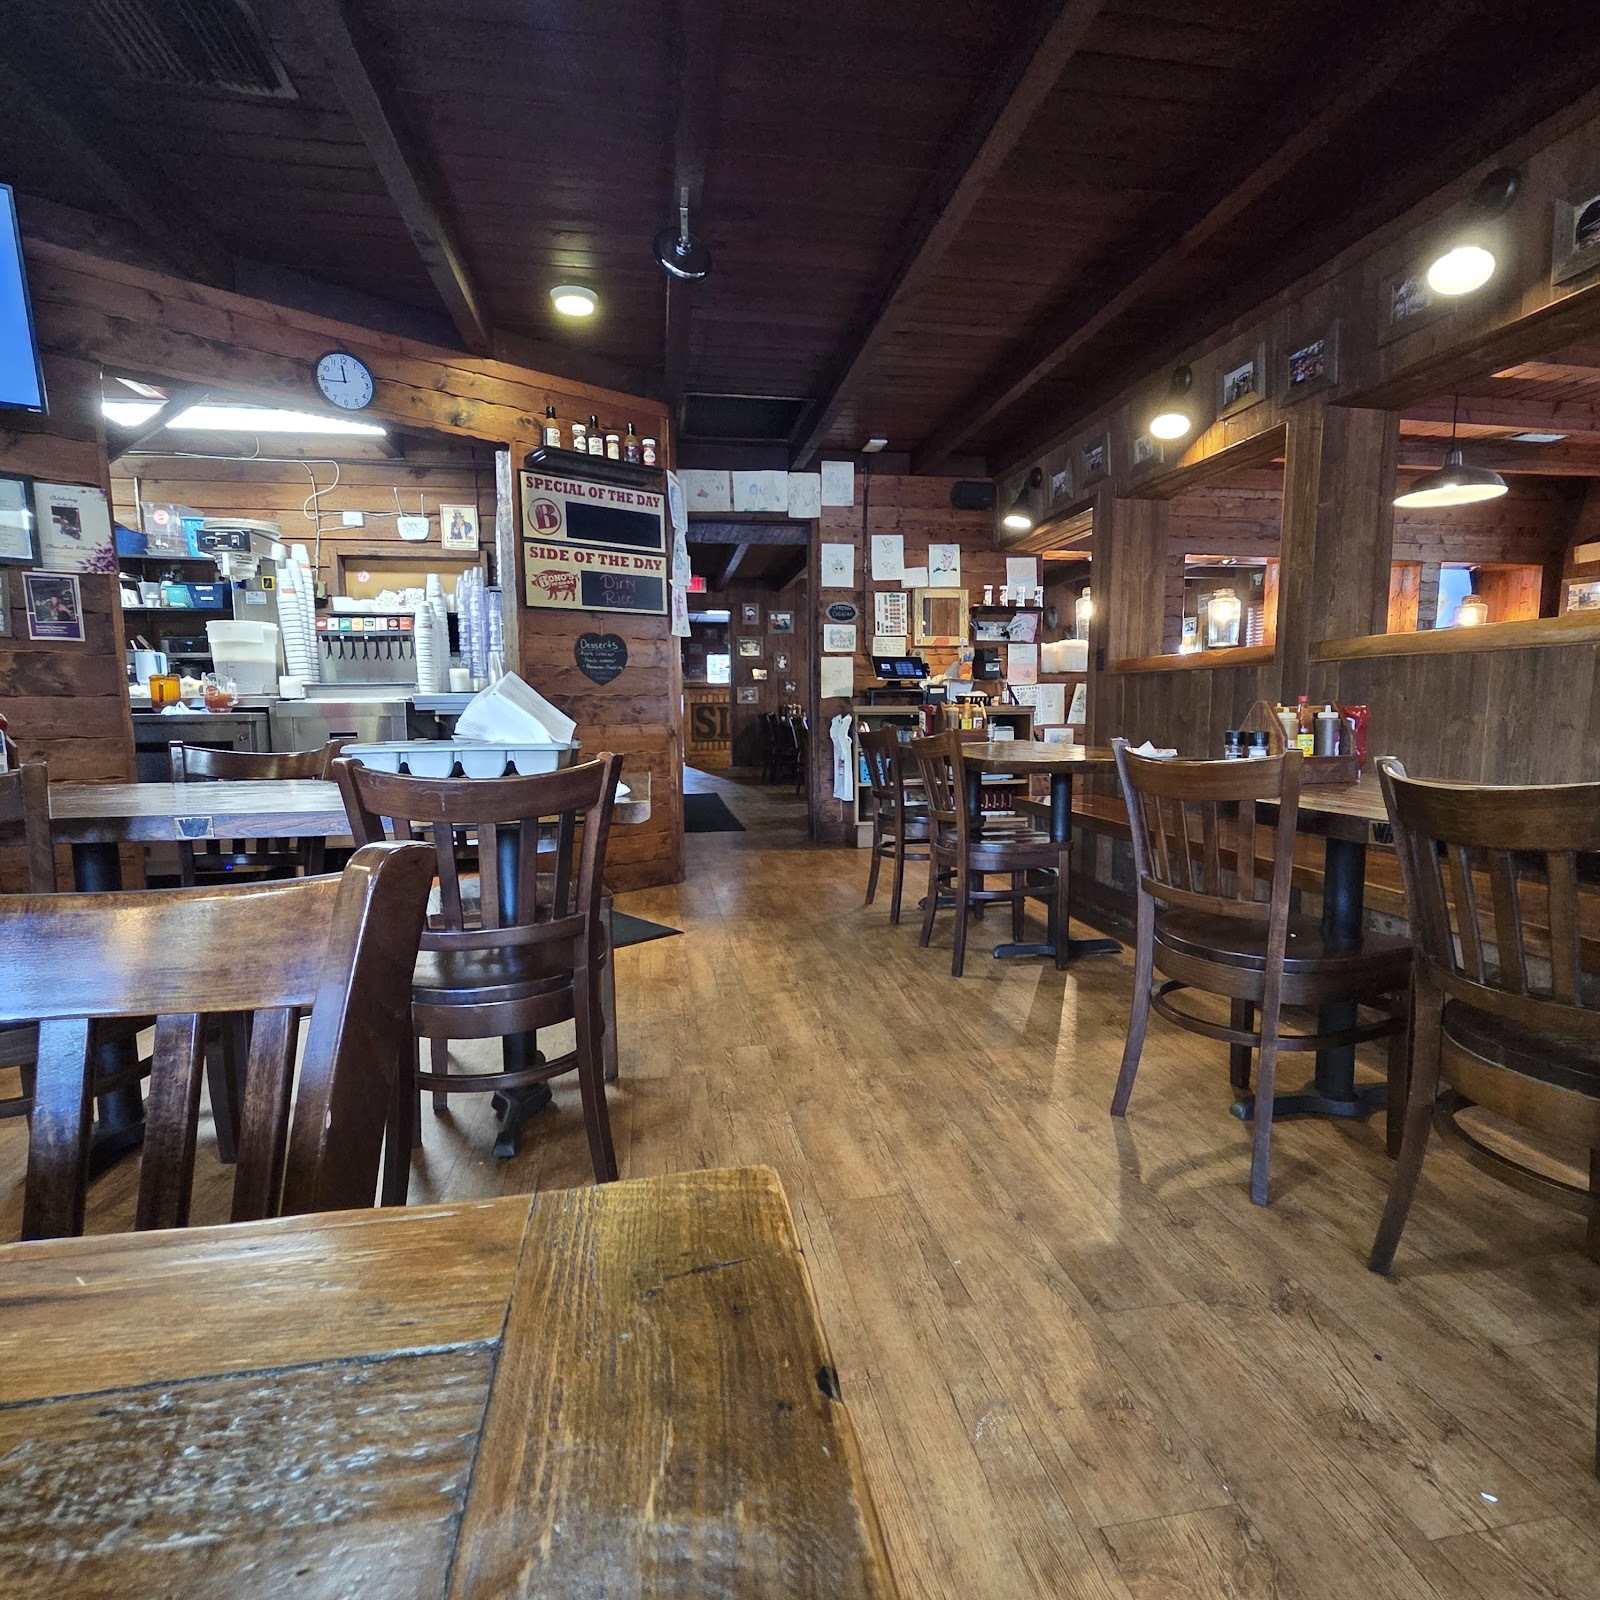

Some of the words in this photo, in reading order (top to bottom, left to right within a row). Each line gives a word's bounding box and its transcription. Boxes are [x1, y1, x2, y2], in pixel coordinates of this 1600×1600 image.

[340, 357, 347, 365] 12
[526, 476, 586, 497] SPECIAL
[588, 486, 606, 500] OF
[607, 489, 634, 504] THE
[636, 493, 661, 508] DAY
[535, 504, 558, 529] B
[529, 546, 569, 561] SIDE
[573, 551, 595, 564] OF
[598, 553, 630, 568] THE
[633, 557, 663, 571] DAY
[600, 574, 636, 592] Dirty
[602, 590, 634, 606] Rice
[580, 638, 619, 650] Desserts
